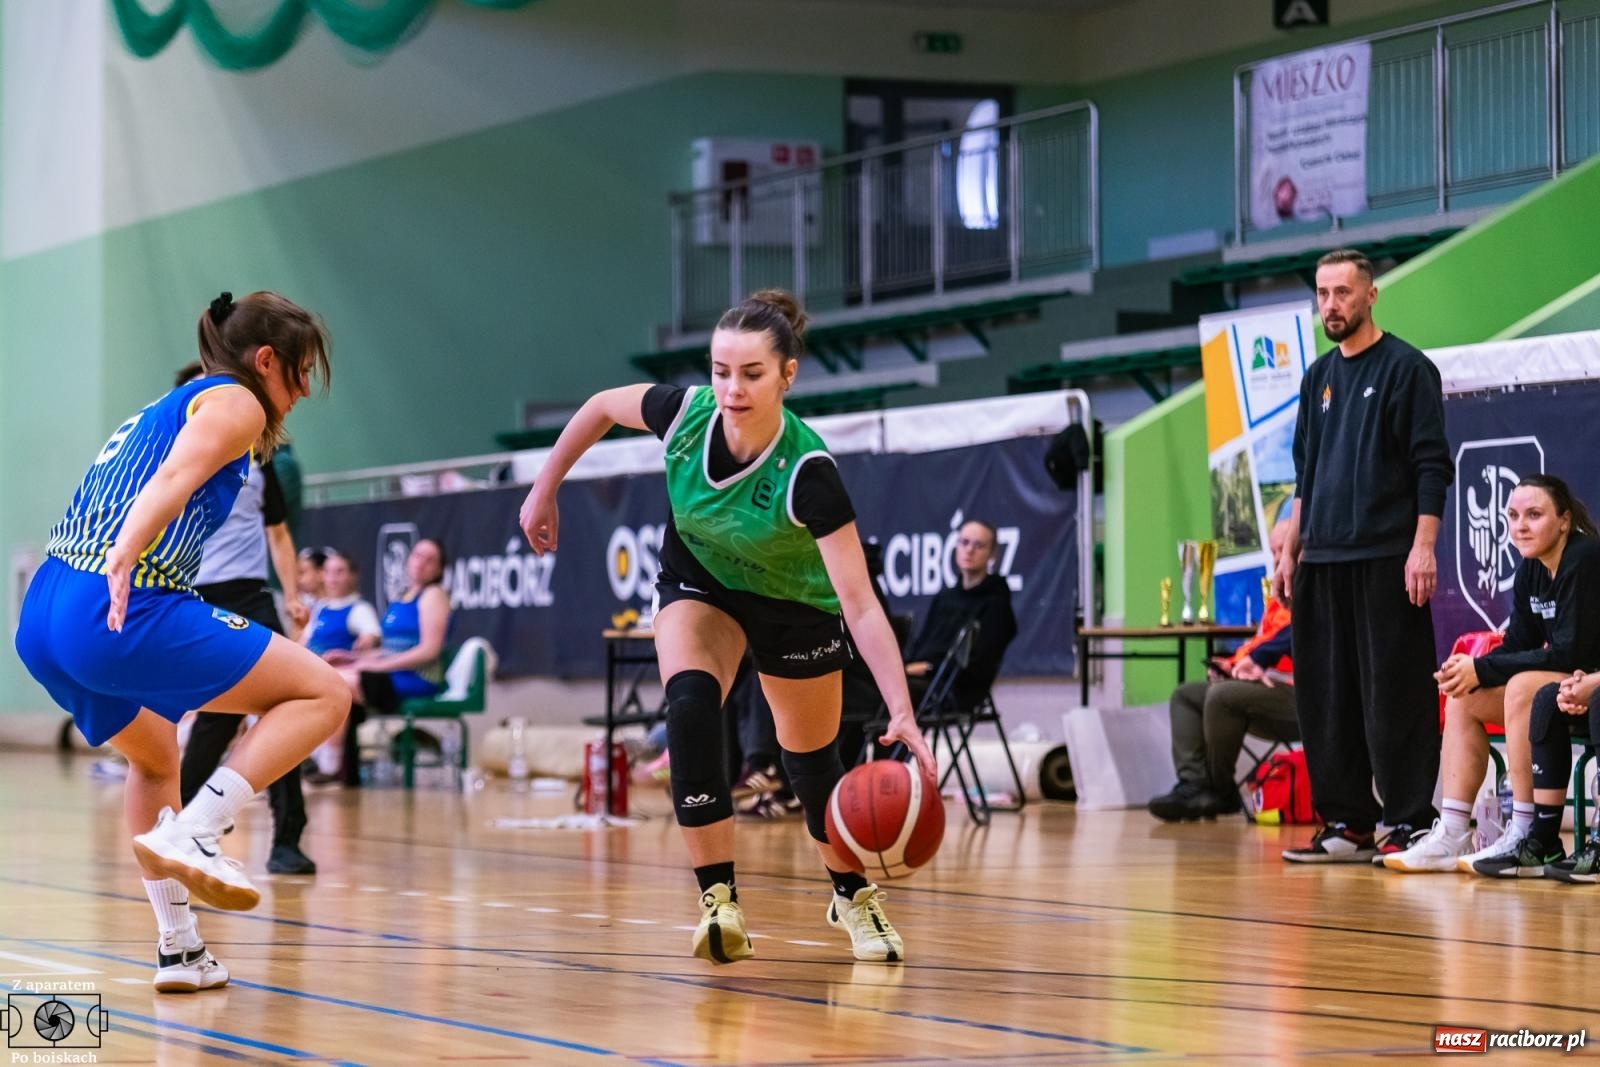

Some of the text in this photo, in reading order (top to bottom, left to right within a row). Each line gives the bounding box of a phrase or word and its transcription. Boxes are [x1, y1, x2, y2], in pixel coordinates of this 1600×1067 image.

[1281, 0, 1318, 24] A
[752, 477, 776, 510] 8
[875, 508, 1023, 597] CIBÓZ
